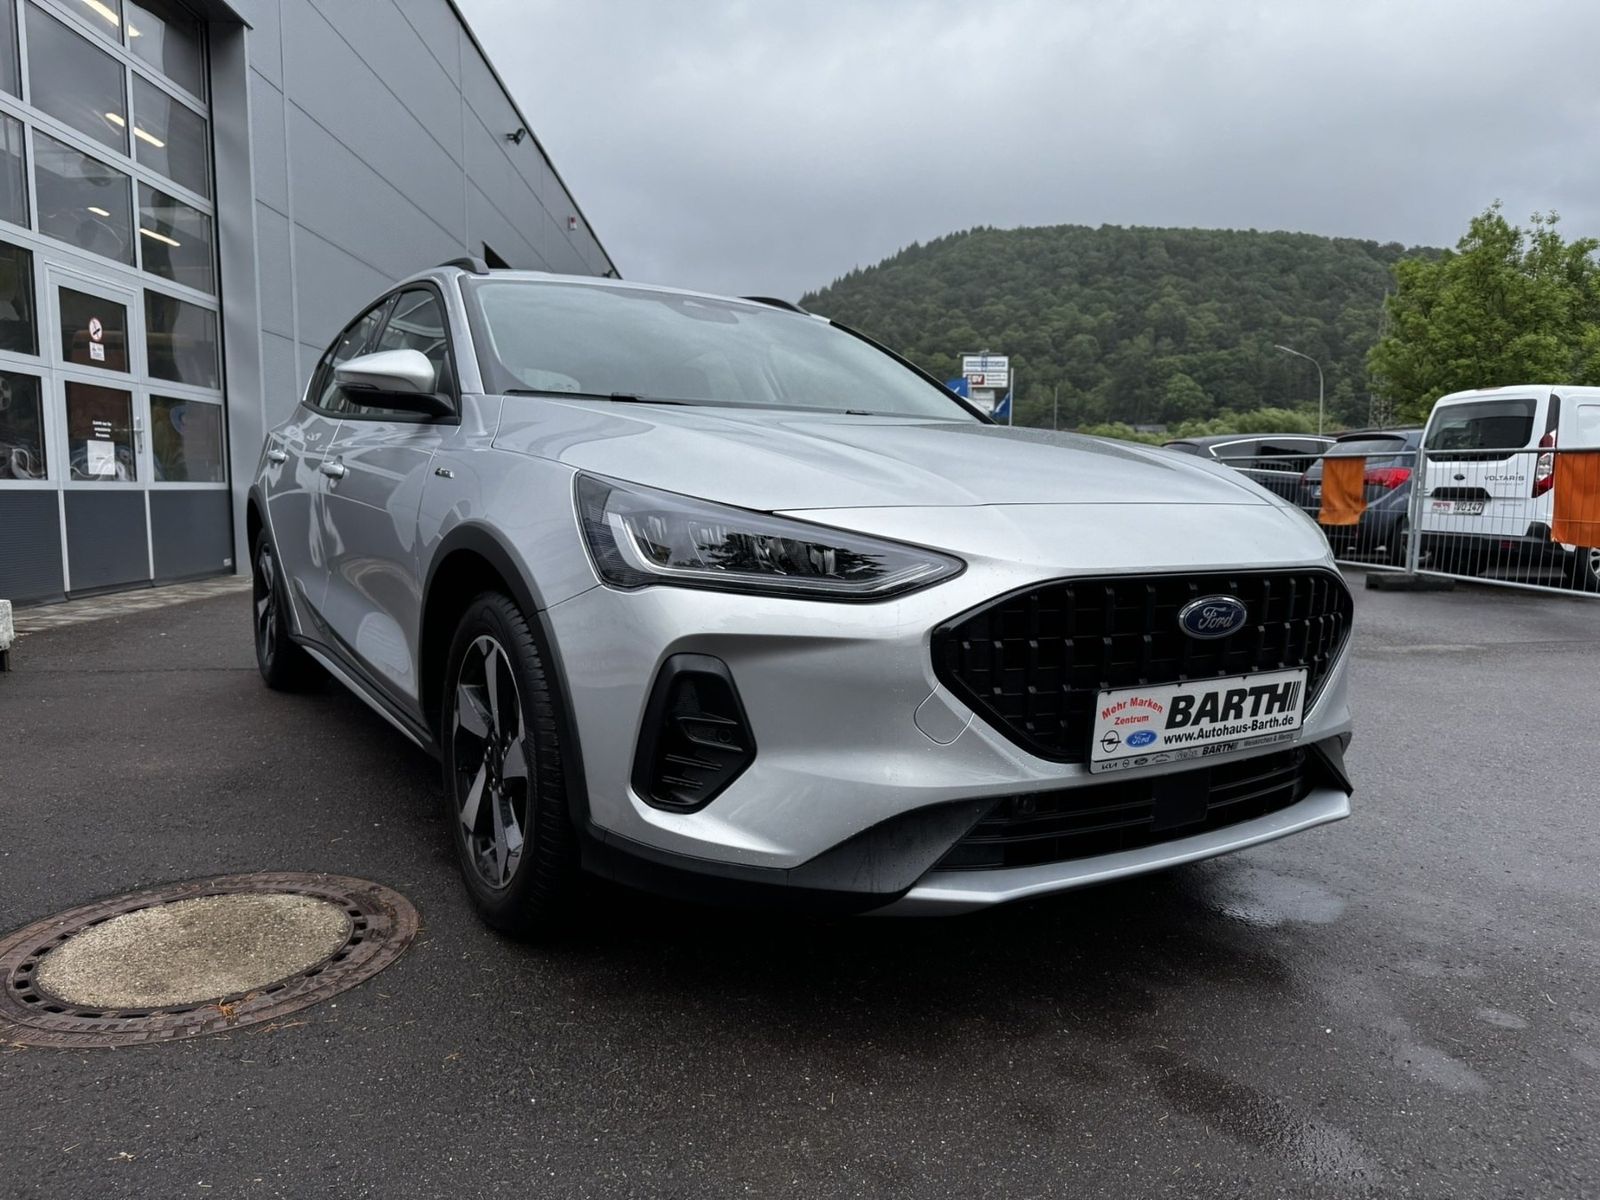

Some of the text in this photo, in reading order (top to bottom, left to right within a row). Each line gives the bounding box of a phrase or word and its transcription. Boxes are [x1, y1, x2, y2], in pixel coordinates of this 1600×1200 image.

[1198, 606, 1235, 629] Ford
[1102, 697, 1163, 720] Mehr Marken
[1165, 682, 1292, 729] BARTH
[1114, 715, 1149, 725] Zentrum
[1163, 714, 1294, 744] www.Autohaus-Barth.de
[1202, 743, 1230, 755] BARTH
